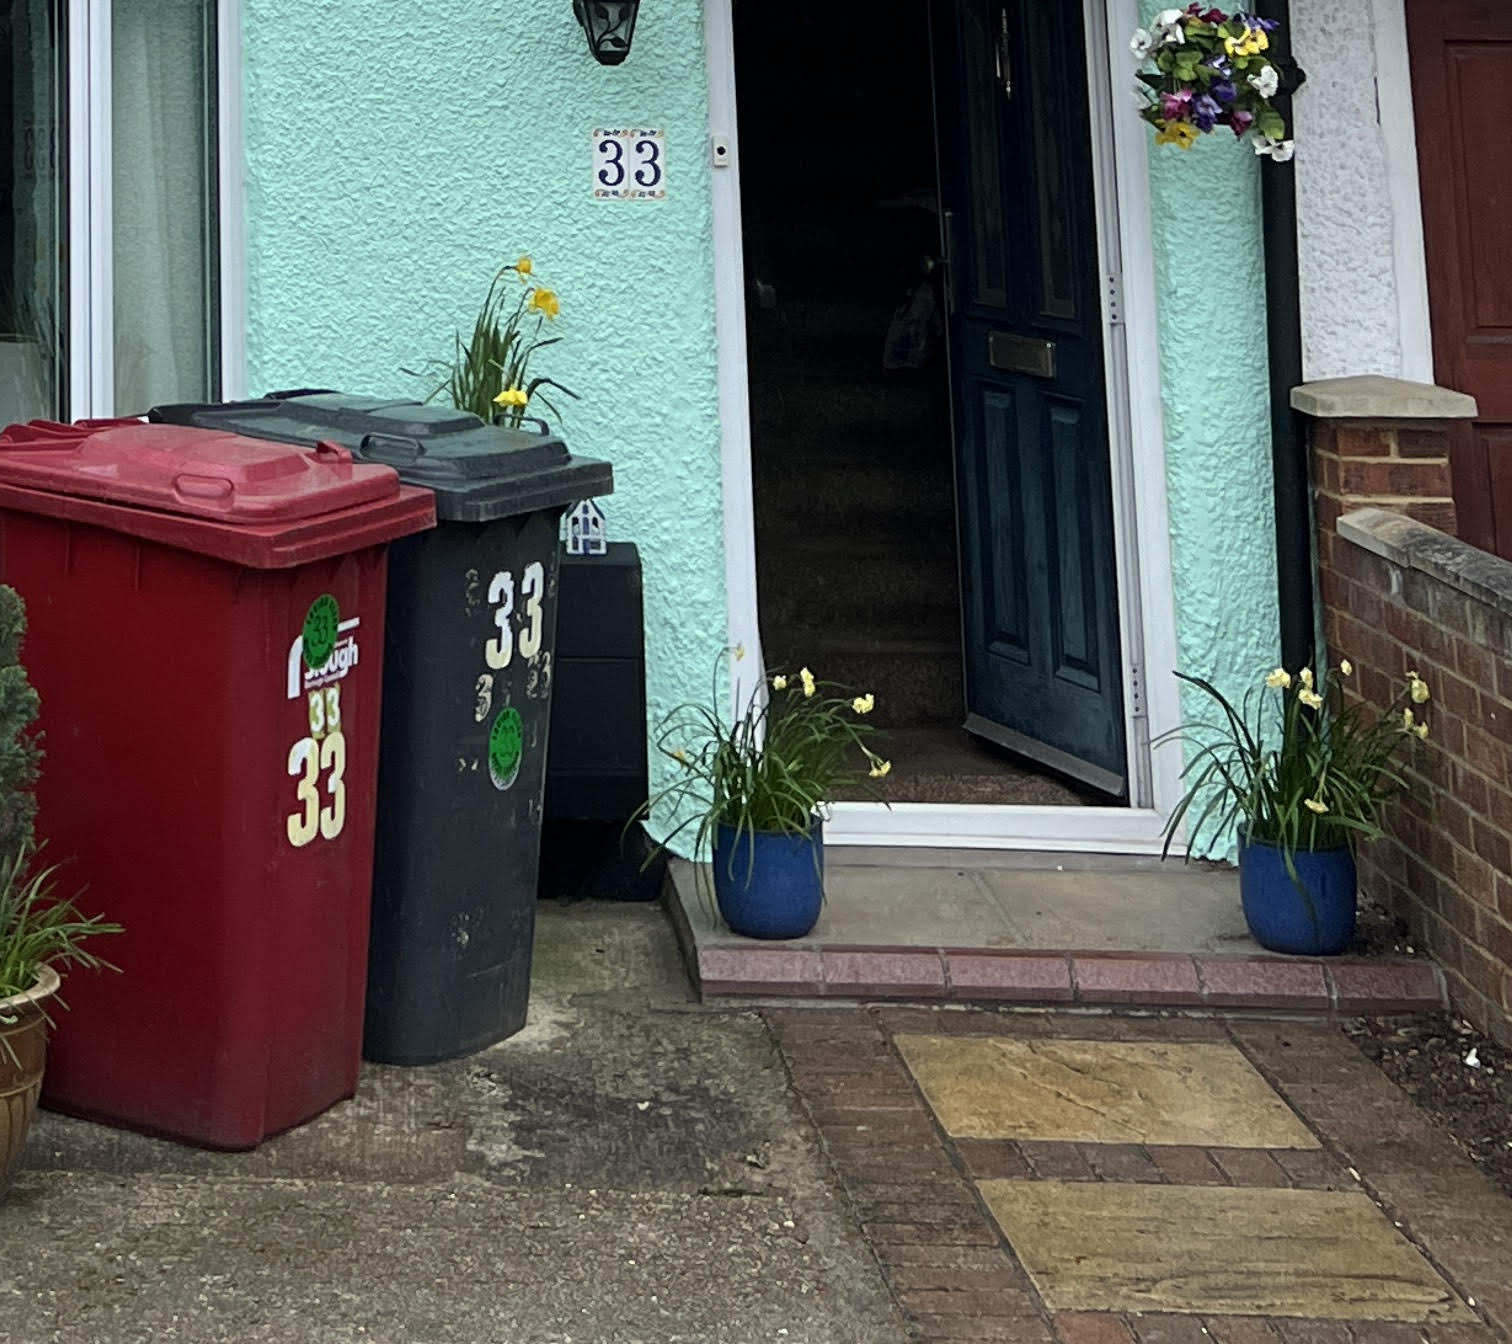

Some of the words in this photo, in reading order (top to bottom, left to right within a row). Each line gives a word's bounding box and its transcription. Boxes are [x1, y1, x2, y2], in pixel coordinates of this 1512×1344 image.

[598, 139, 661, 187] 33
[486, 562, 544, 670] 33
[304, 635, 359, 680] ugh
[310, 687, 341, 733] 33
[287, 732, 346, 847] 33
